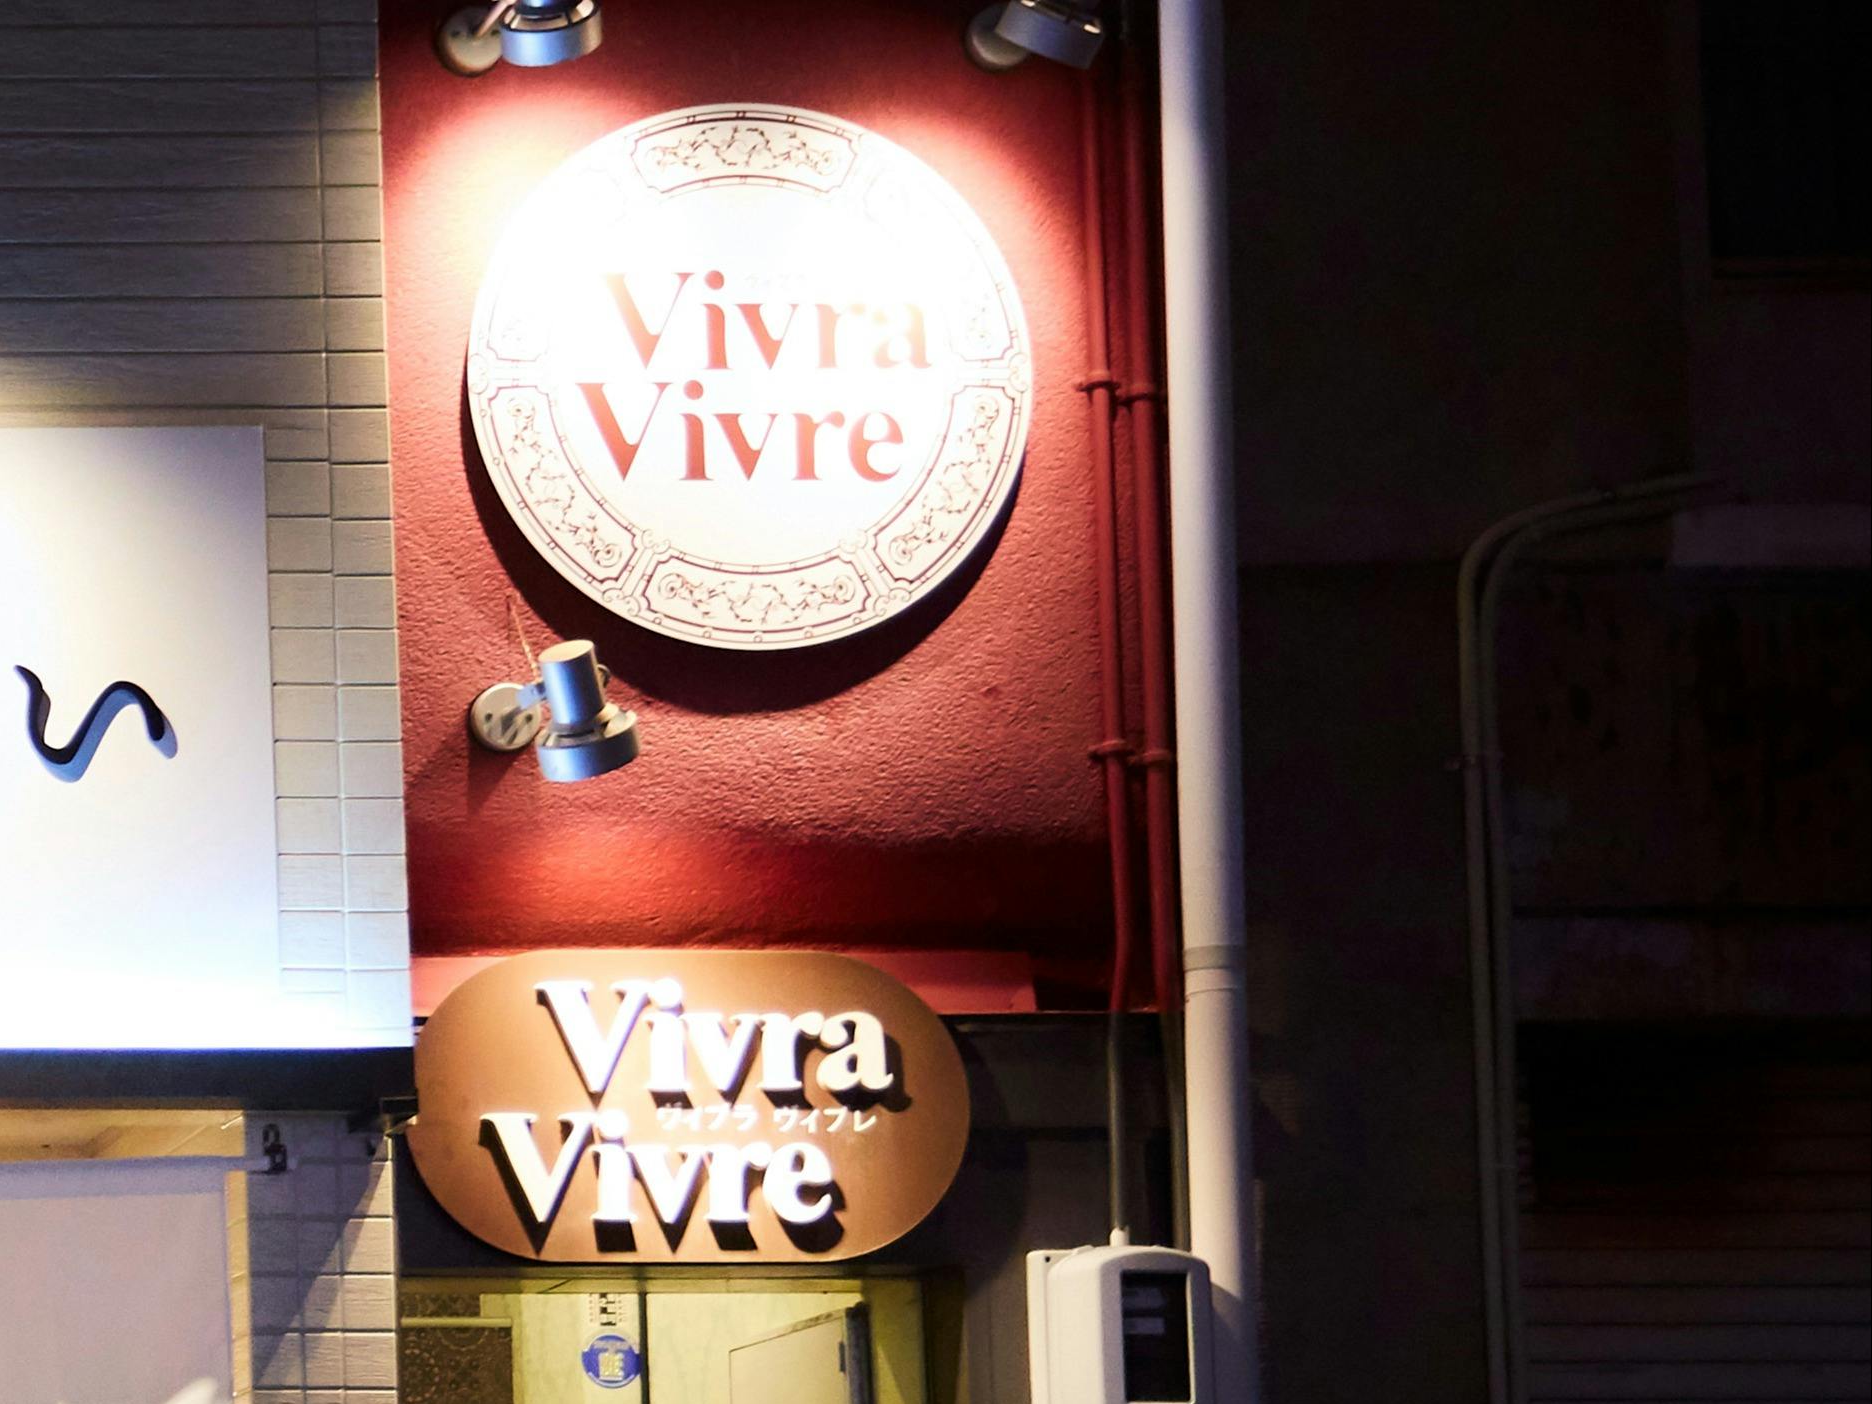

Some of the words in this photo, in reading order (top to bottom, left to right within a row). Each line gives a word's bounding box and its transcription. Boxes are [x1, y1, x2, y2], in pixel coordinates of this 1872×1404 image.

[601, 269, 933, 371] Vivra
[574, 379, 905, 483] Vivre
[534, 977, 897, 1102] Vivra
[478, 1109, 837, 1240] Vivre
